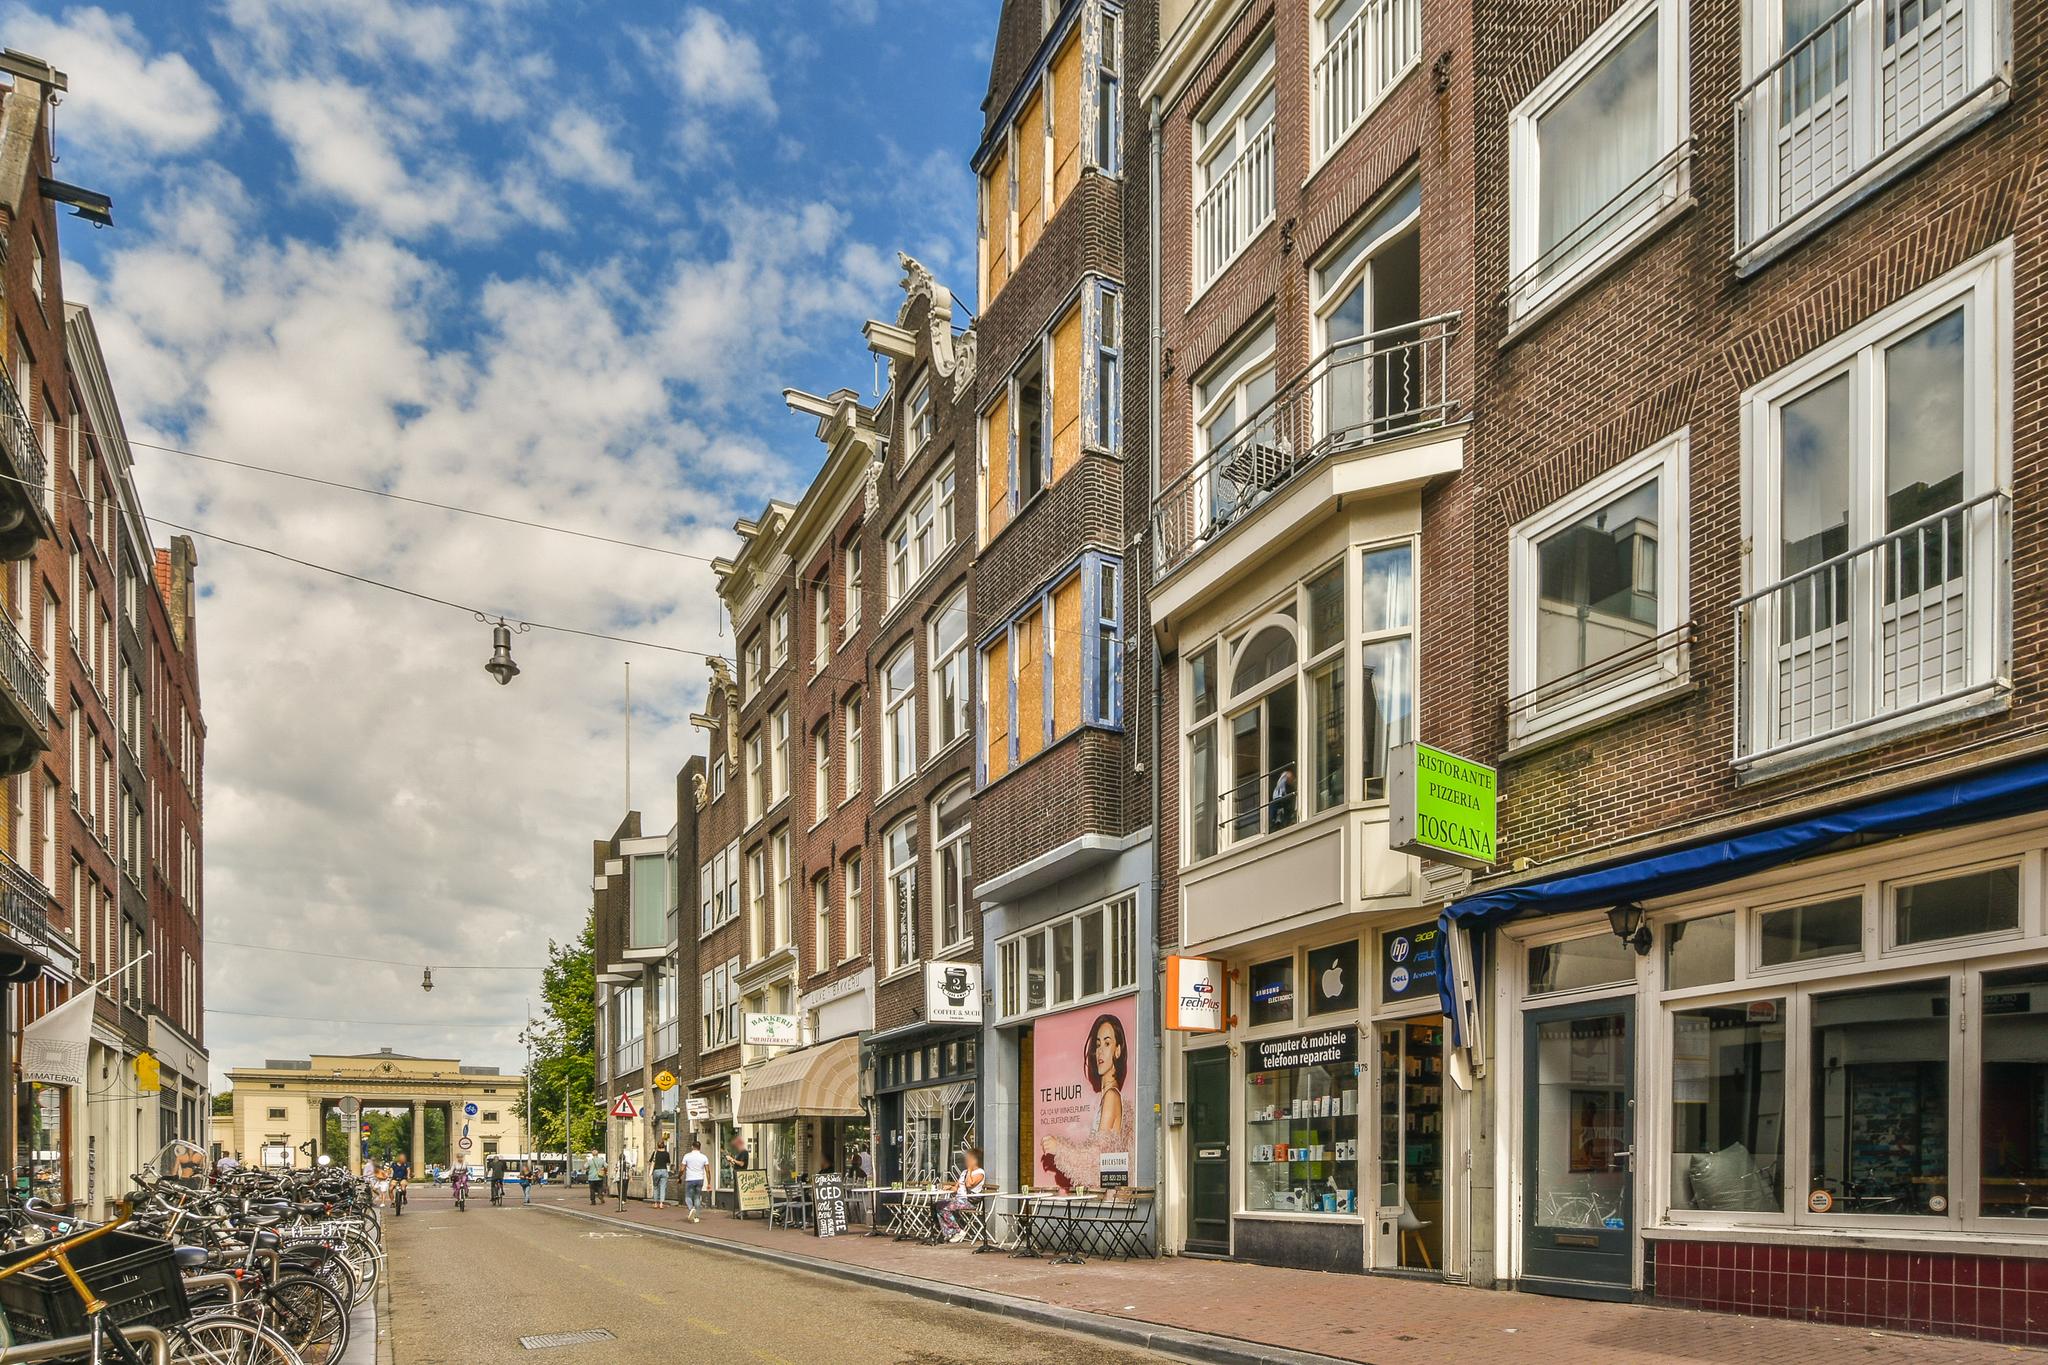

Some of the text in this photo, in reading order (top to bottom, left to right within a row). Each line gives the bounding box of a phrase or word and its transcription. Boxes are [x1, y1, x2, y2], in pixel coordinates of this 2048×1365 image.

[1418, 752, 1492, 789] RISTORANTE
[1429, 782, 1480, 811] PIZZERIA
[1418, 813, 1491, 854] TOSCANA
[1415, 928, 1437, 943] acer
[1392, 938, 1407, 961] hp
[1392, 974, 1407, 983] DELL
[1413, 970, 1436, 980] lenov
[1255, 987, 1280, 997] SAMSUNG
[1267, 993, 1296, 1004] ELECTRONICS
[1180, 996, 1220, 1009] TechPlus
[933, 1008, 957, 1016] COFFEE
[751, 1015, 794, 1029] BAKKERIJ
[1260, 1030, 1347, 1055] Computer & mobiele
[1263, 1047, 1341, 1069] telefoon reparatie
[1040, 1084, 1082, 1103] TE HUUR
[815, 1186, 841, 1200] ICED
[834, 1200, 847, 1232] COFFEE
